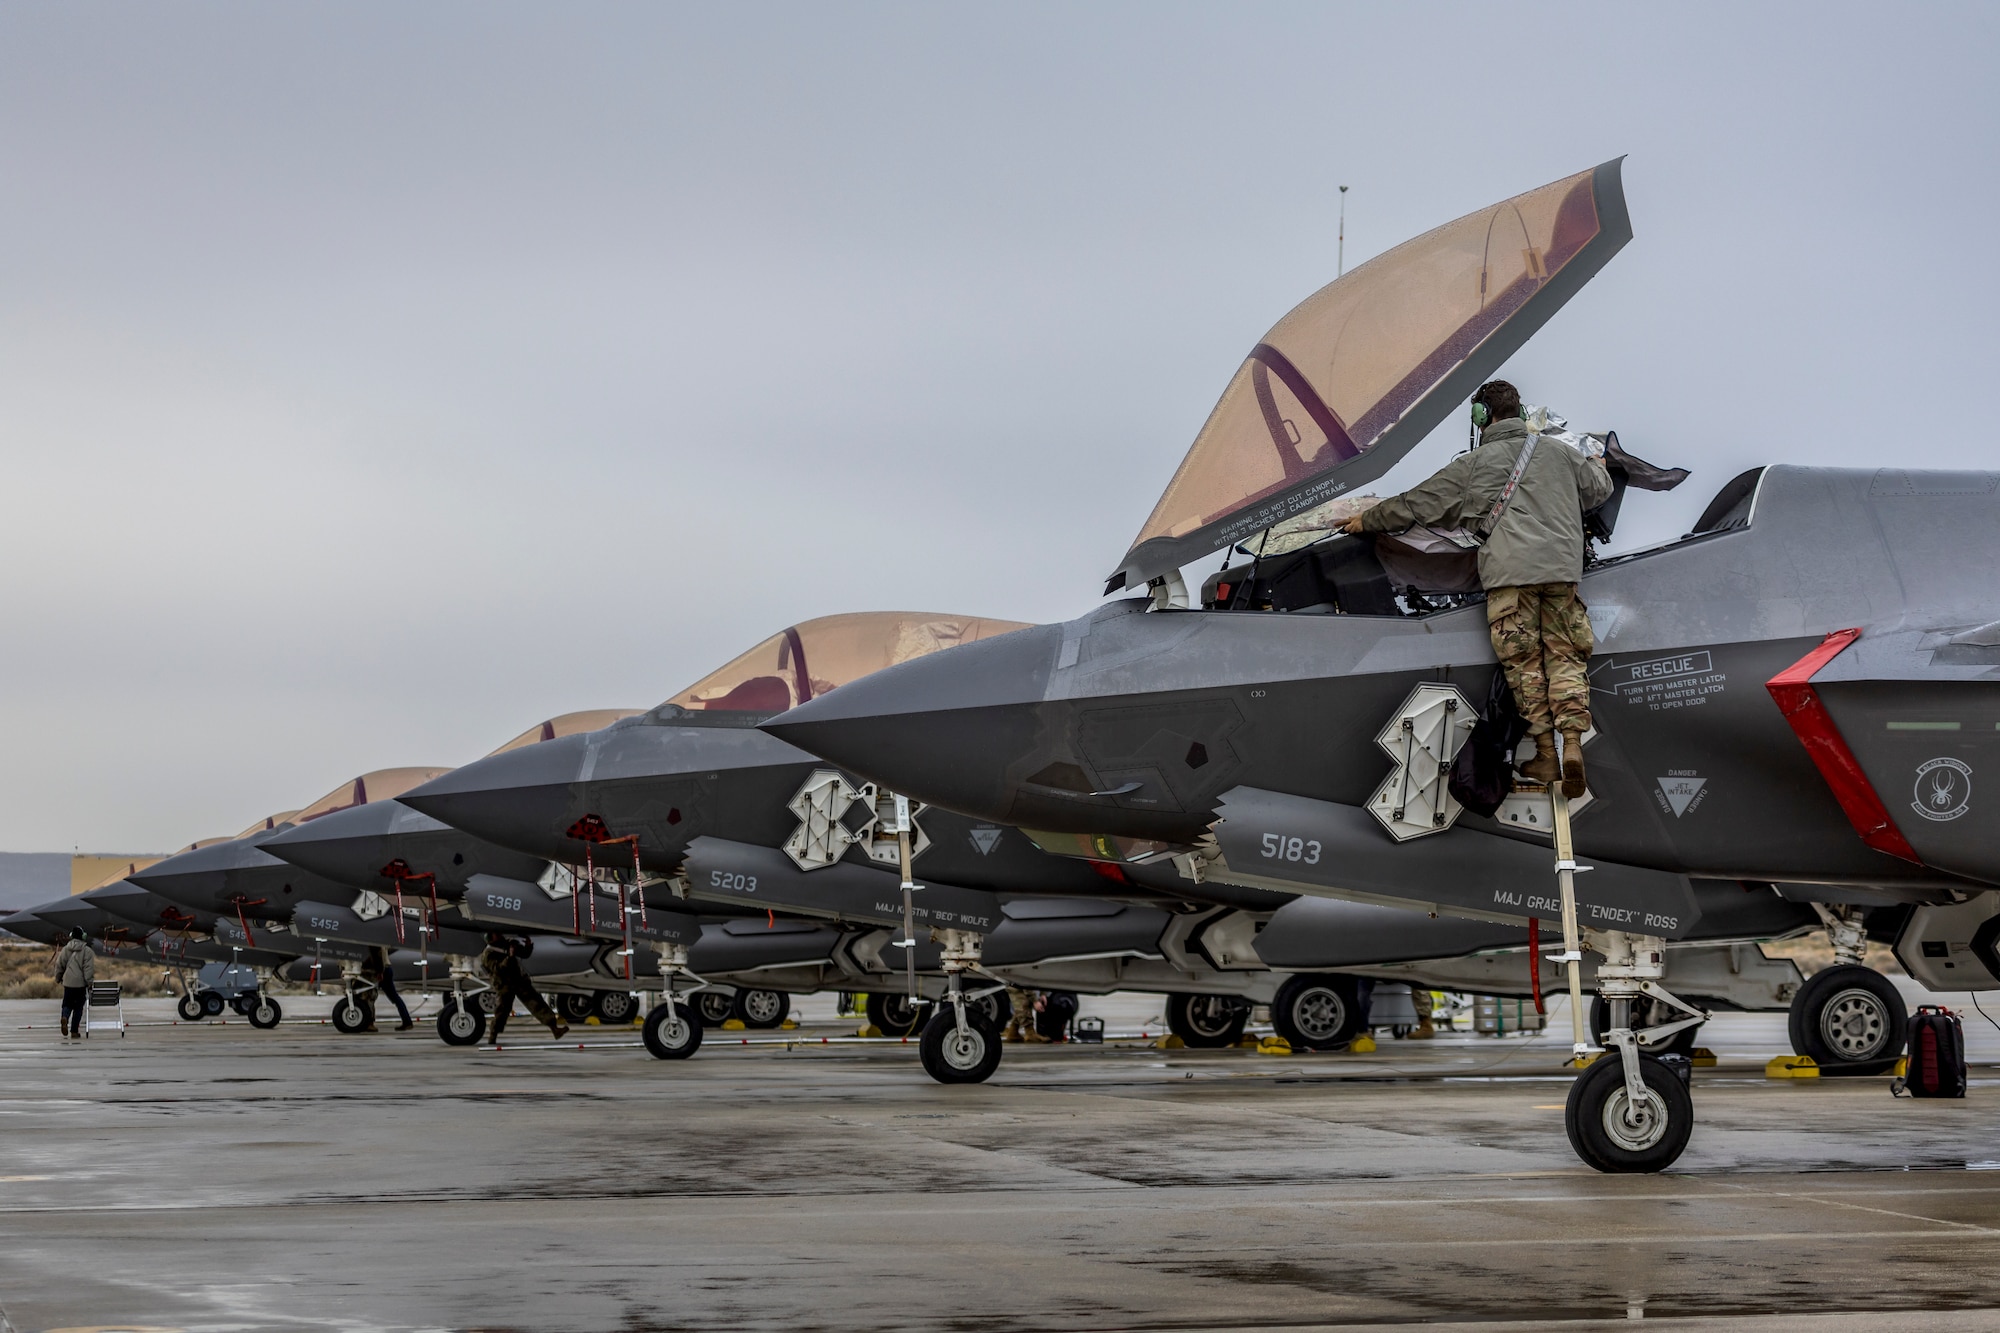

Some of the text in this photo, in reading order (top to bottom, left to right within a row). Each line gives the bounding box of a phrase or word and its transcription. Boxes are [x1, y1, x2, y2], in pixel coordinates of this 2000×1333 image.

[1214, 531, 1239, 546] WITHIN
[1249, 515, 1275, 531] INCHES
[1276, 509, 1286, 518] OF
[1289, 494, 1319, 512] CANOPY
[1320, 482, 1347, 499] FRAME
[1220, 516, 1253, 535] WARNING
[1259, 508, 1269, 518] DO
[1271, 501, 1286, 512] NOT
[1287, 493, 1303, 505] CUT
[1305, 478, 1335, 496] CANOPY
[1631, 657, 1694, 679] RESCUE
[1623, 674, 1726, 696] TURN FWD MASTER LATCH
[1628, 684, 1725, 705] AND AFT MASTER LATCH
[1649, 697, 1706, 711] TO OPEN DOOR
[1668, 769, 1697, 777] DANGER
[1654, 788, 1671, 814] DANGER
[1668, 788, 1693, 796] INTAKE
[1687, 788, 1708, 814] DANGER
[1260, 832, 1322, 865] 5183
[710, 870, 757, 892] 5203
[486, 894, 521, 911] 5368
[1494, 889, 1678, 930] MAJ GRAE "ENDEX" ROSS
[310, 917, 339, 931] 5452
[875, 902, 894, 913] MAJ
[896, 905, 928, 918] KSTIN
[960, 914, 989, 927] WOLFE
[229, 929, 252, 941] 545
